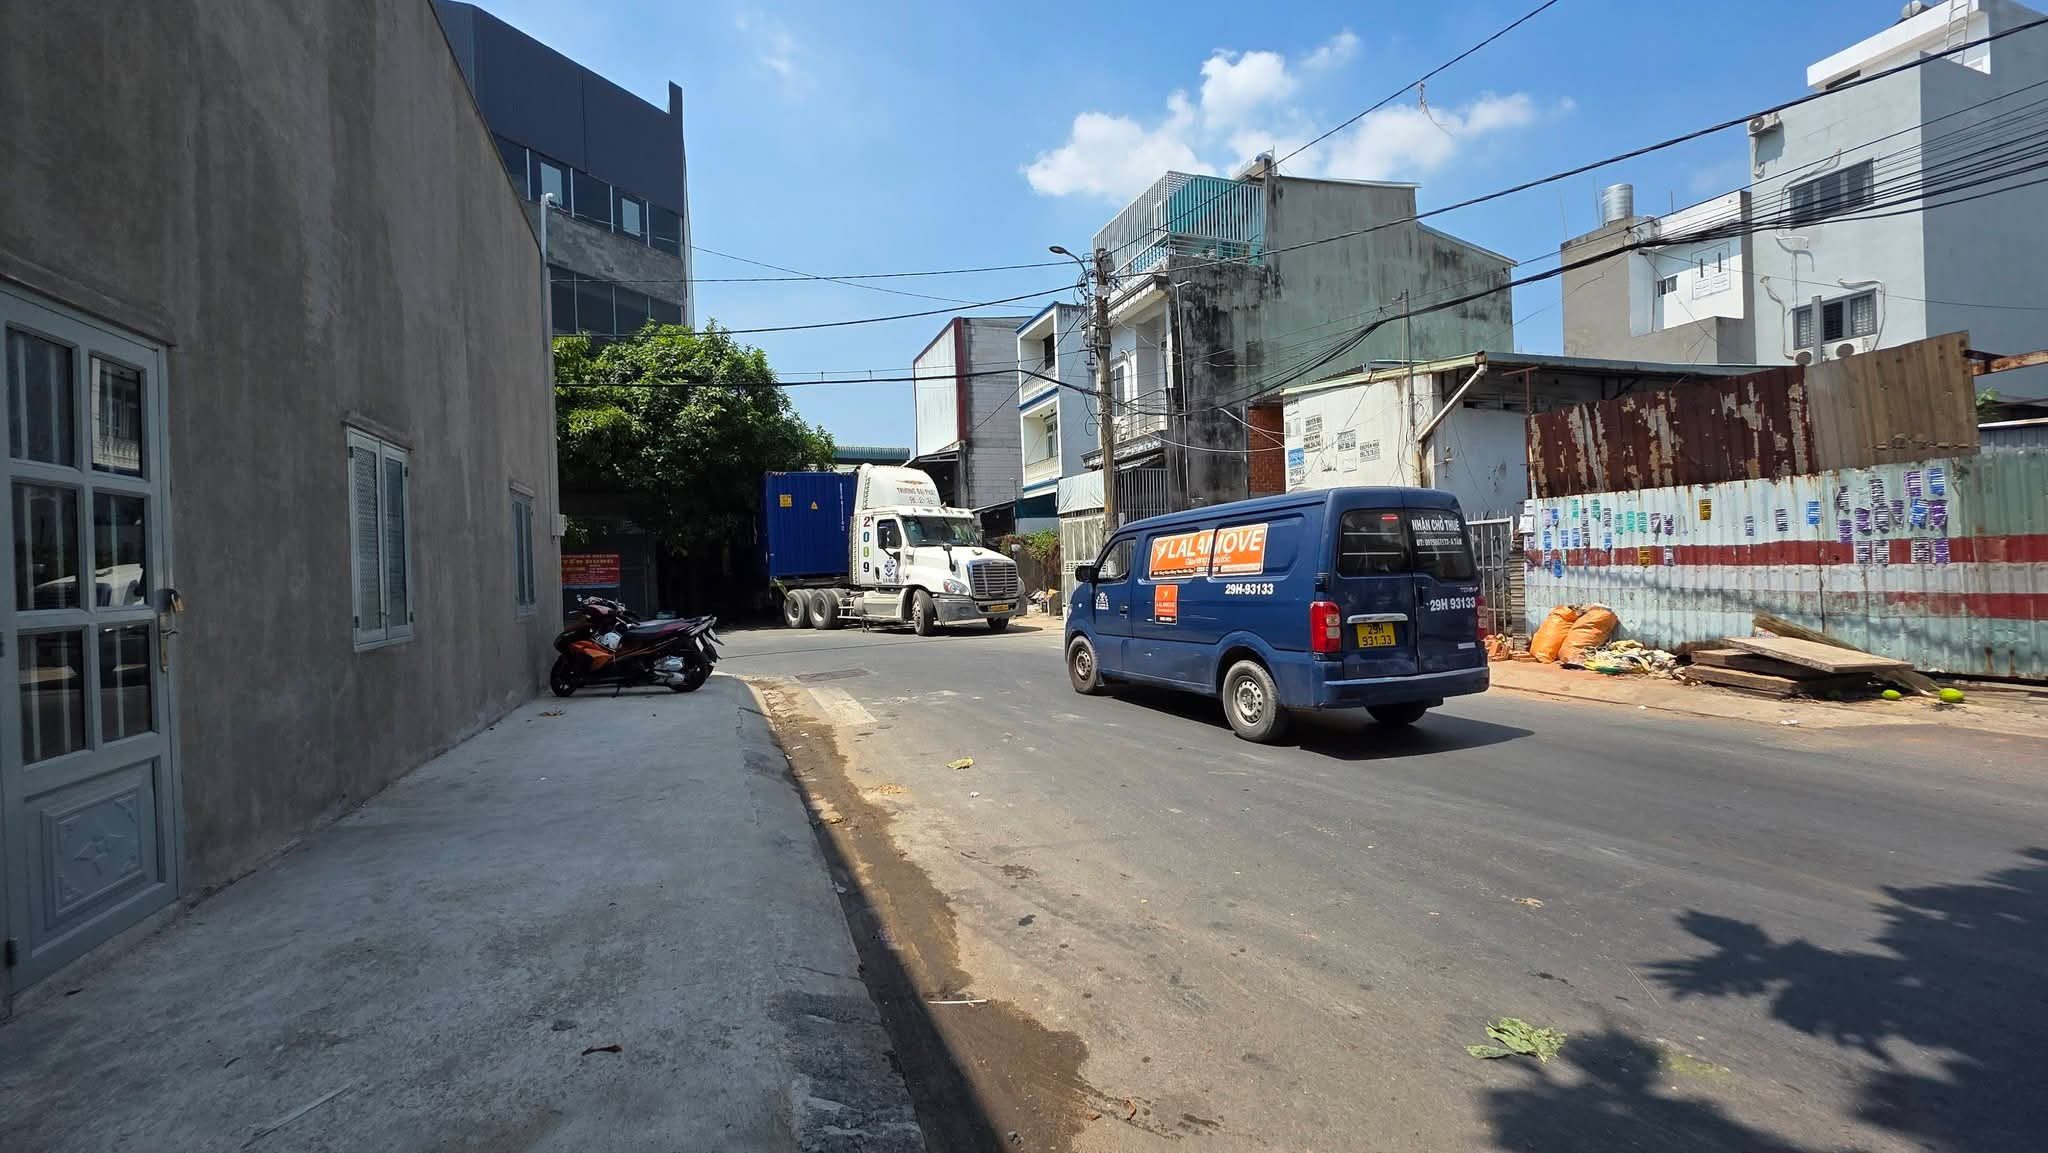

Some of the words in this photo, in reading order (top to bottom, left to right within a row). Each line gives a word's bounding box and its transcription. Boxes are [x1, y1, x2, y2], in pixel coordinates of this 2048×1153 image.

[1167, 529, 1264, 559] LALAMOVE
[1225, 583, 1274, 595] 29H-93133
[1430, 599, 1448, 611] 29H
[1450, 597, 1476, 609] 93133
[1367, 624, 1384, 634] 29H
[1362, 634, 1392, 646] 931.33
